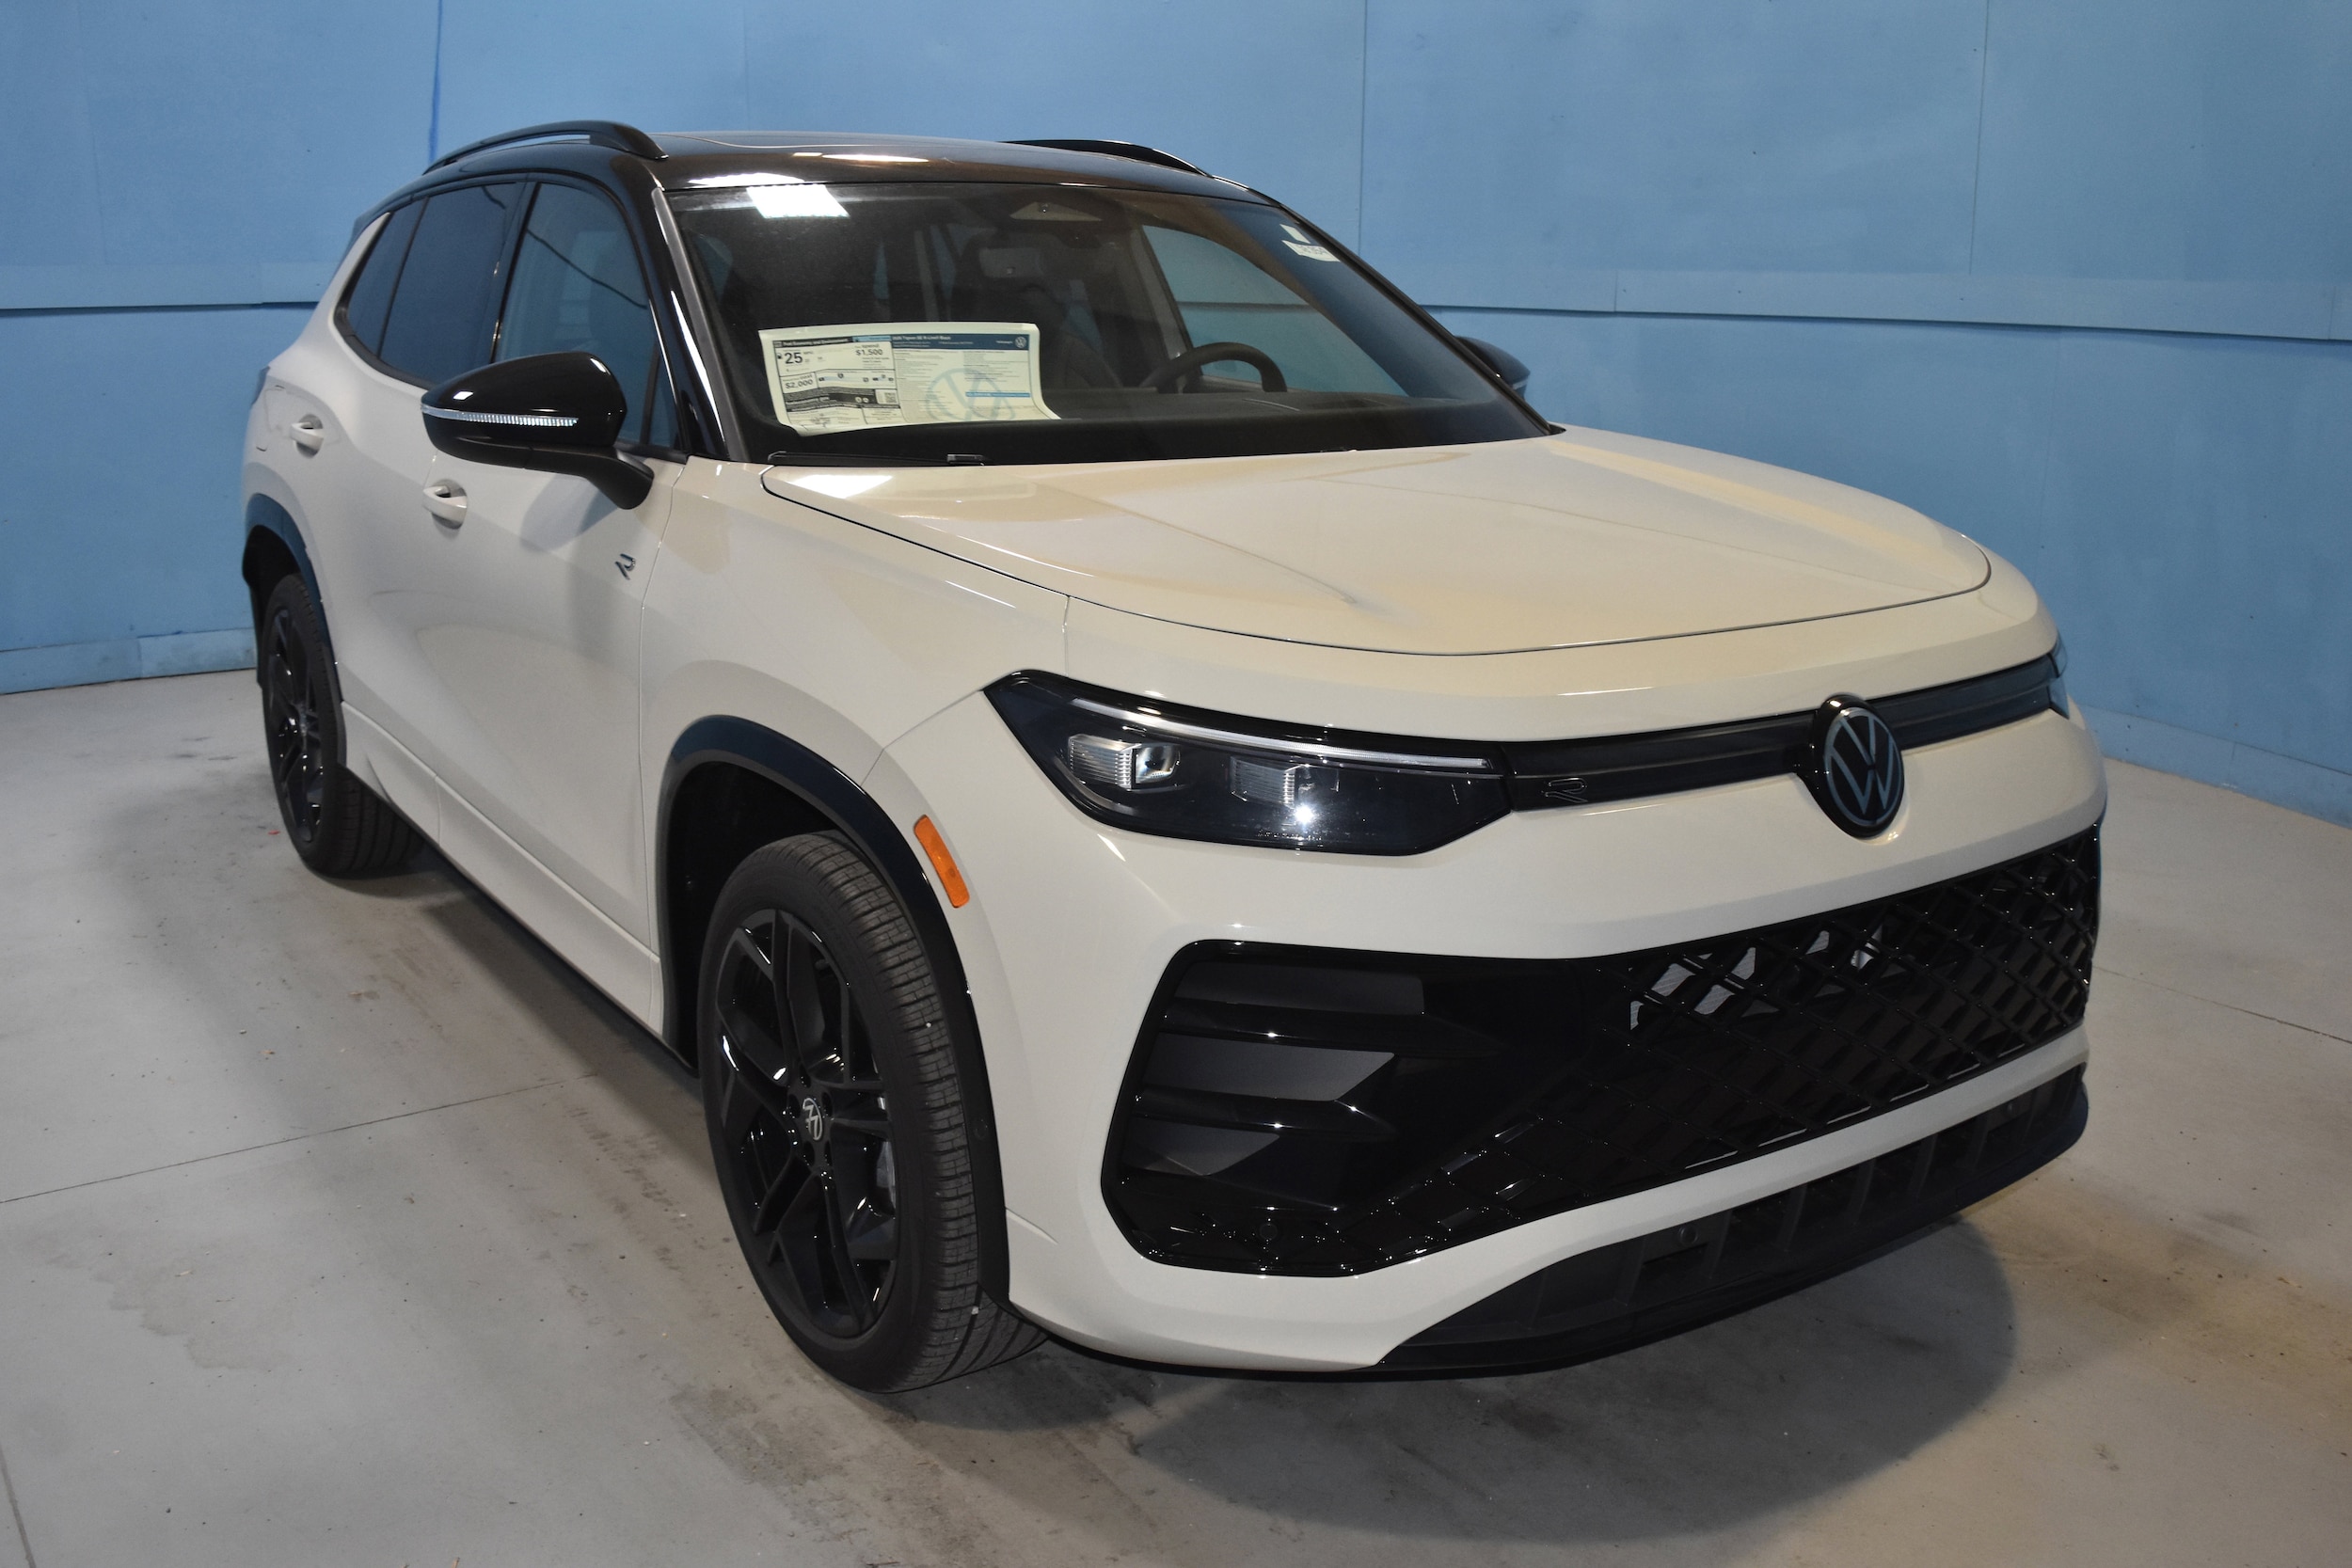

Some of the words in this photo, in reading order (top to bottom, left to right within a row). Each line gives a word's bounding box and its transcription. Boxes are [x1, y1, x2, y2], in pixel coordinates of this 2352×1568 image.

[784, 352, 803, 365] 25
[855, 348, 883, 356] $1,500
[785, 378, 814, 389] $2,000
[614, 553, 636, 580] R
[1825, 708, 1902, 824] VW
[1544, 777, 1589, 803] R
